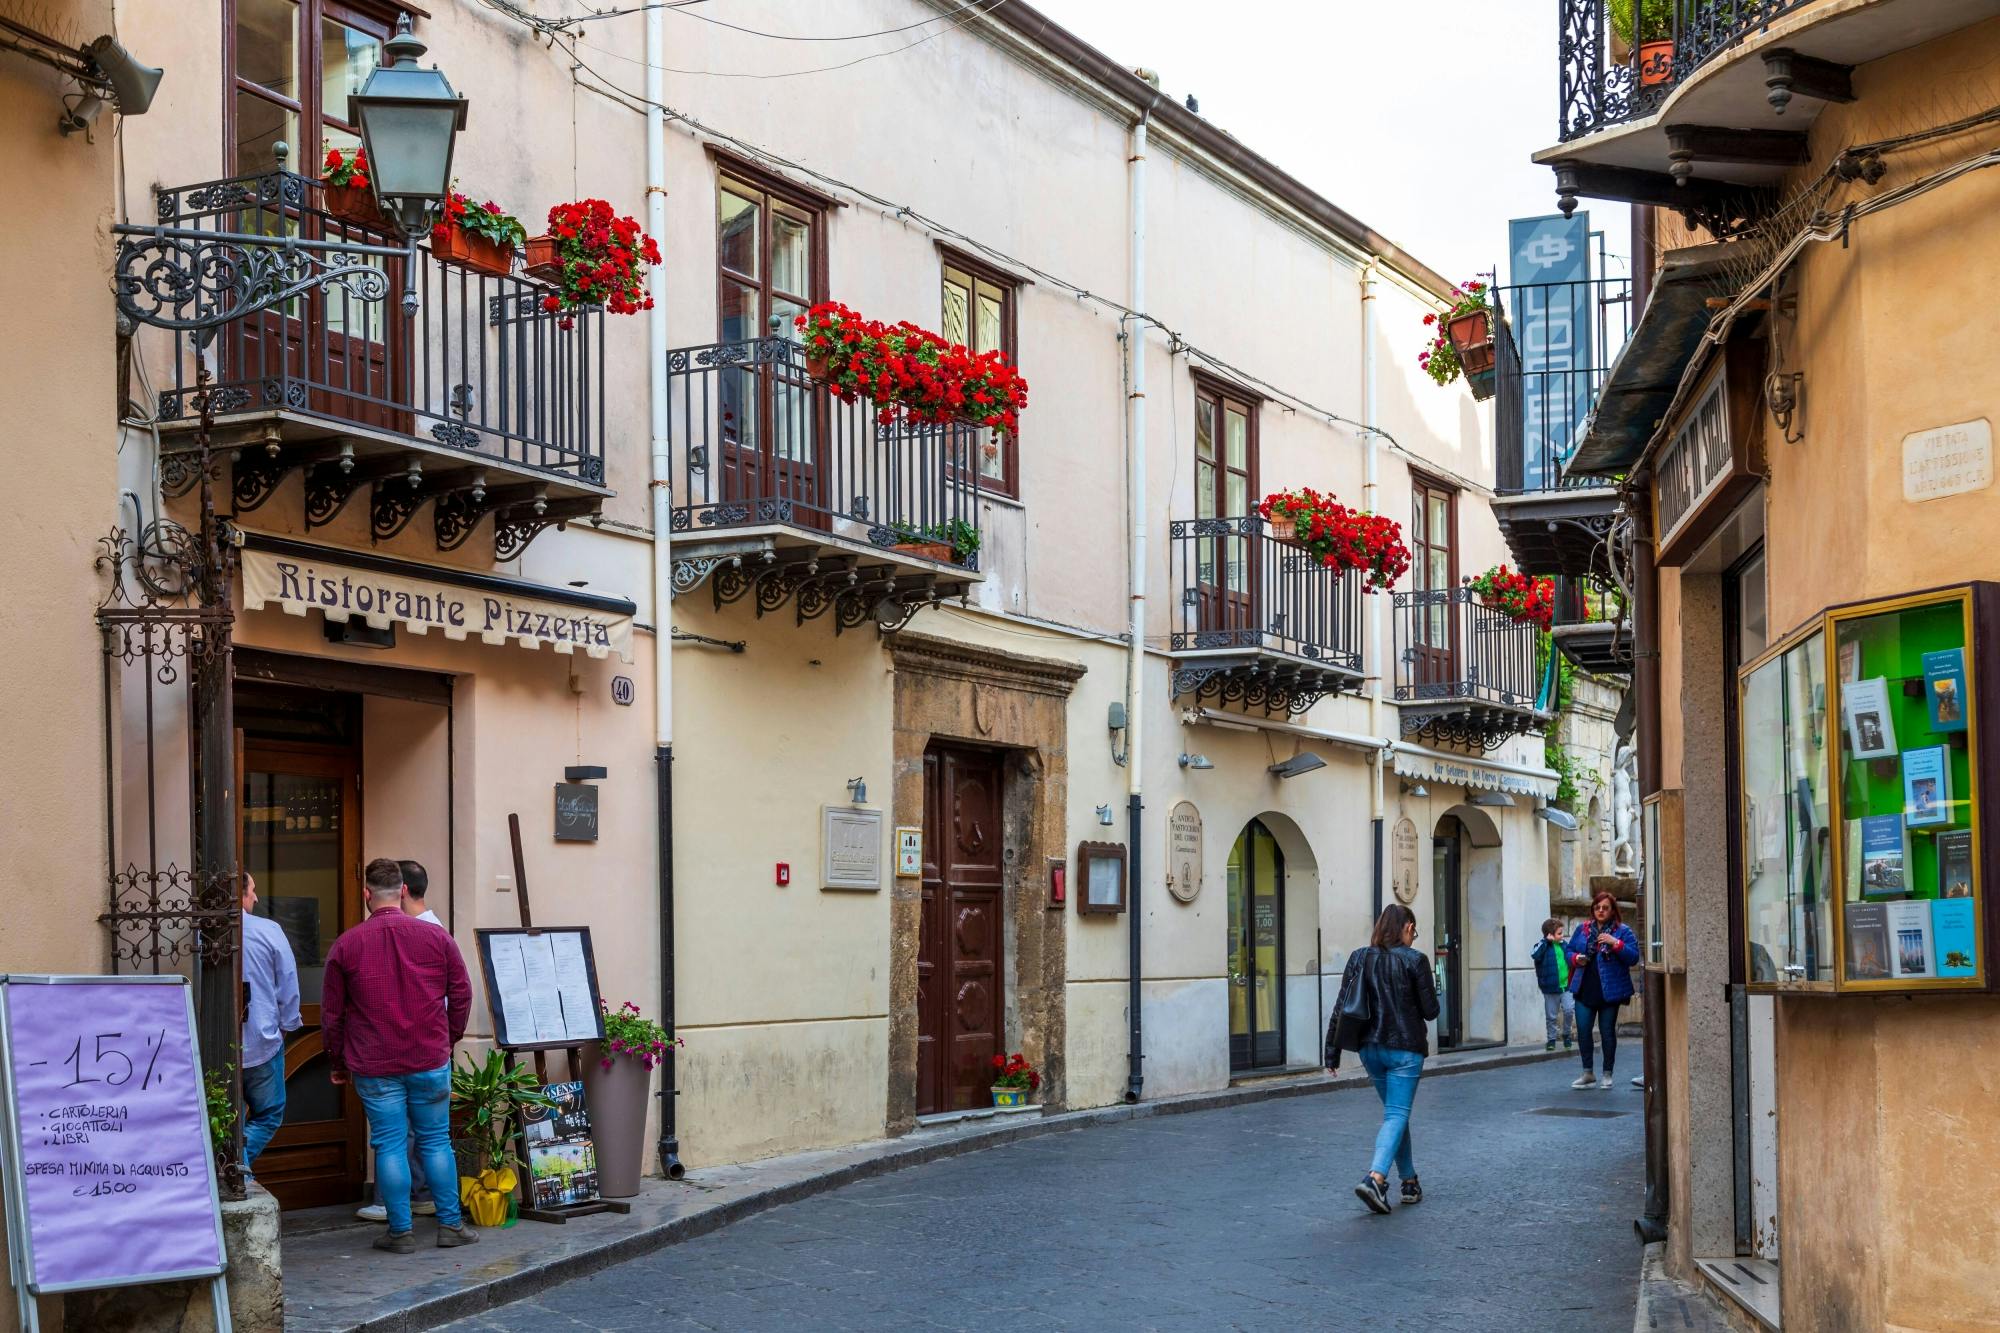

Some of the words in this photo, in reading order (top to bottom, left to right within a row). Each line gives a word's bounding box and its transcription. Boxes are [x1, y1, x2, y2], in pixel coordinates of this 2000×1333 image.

[1908, 447, 1985, 475] L'AFFISSIOE
[276, 561, 466, 627] Ristorante
[482, 597, 612, 648] Pizzeria
[616, 681, 630, 700] 40
[48, 1103, 129, 1120] CARTOLERIA
[50, 1118, 123, 1133] GIOCATTOLI
[51, 1132, 89, 1146] LIBRI
[24, 1162, 65, 1176] SPESA
[69, 1161, 110, 1176] MINIMA
[113, 1162, 126, 1175] DI
[130, 1162, 189, 1177] ACQUISTO
